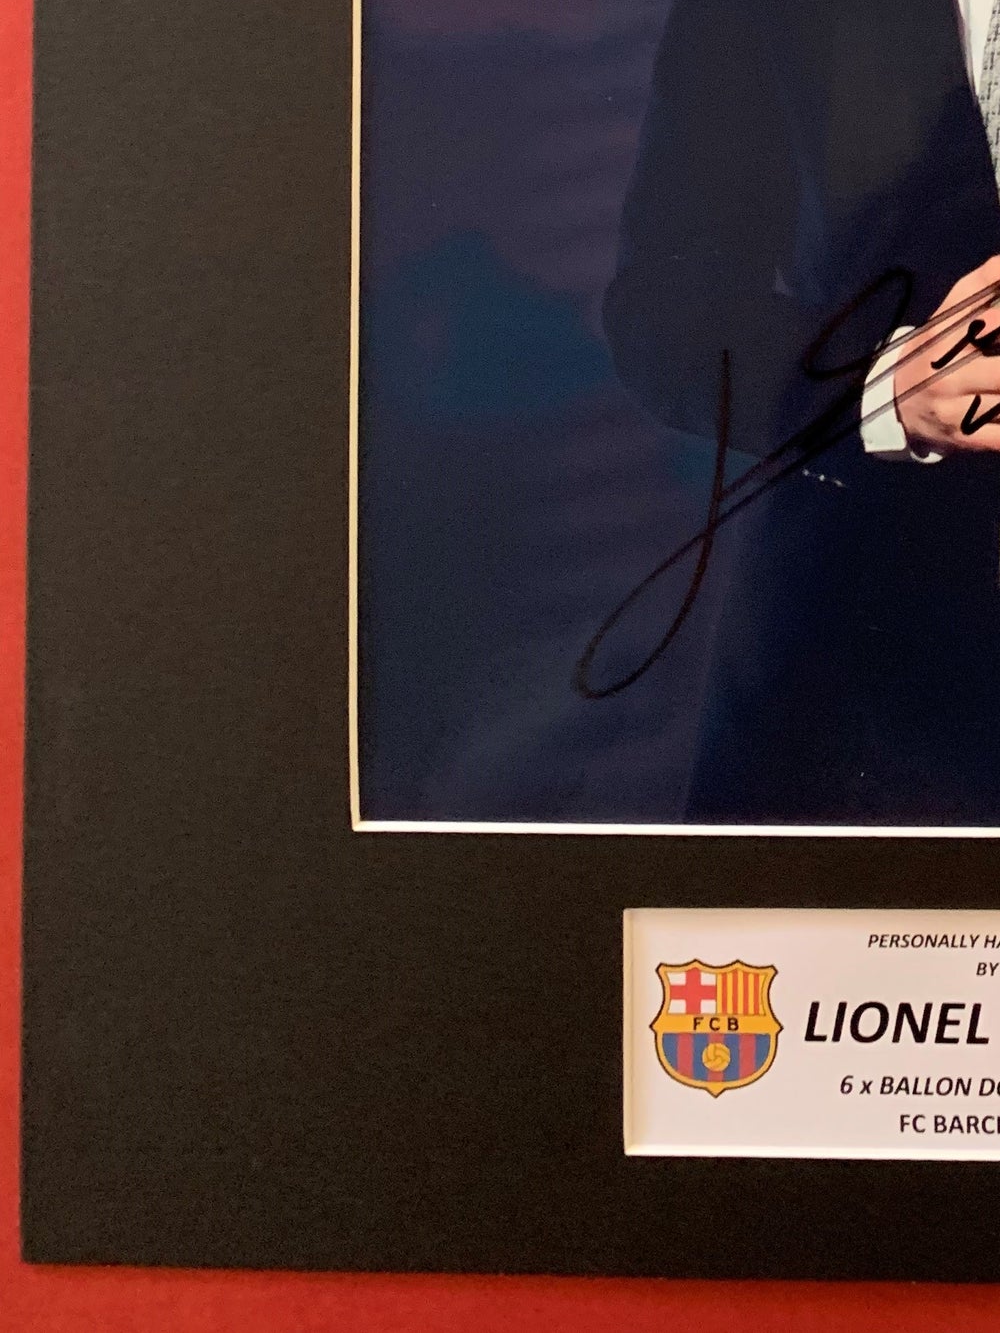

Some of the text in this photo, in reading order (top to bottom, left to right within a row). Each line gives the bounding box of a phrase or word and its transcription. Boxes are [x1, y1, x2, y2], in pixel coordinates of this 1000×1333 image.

[867, 933, 980, 949] PERSONALLY
[976, 962, 1000, 977] BY
[804, 1001, 990, 1045] LIONEL
[840, 1075, 854, 1095] 6
[859, 1080, 873, 1096] x
[879, 1076, 972, 1097] BALLON
[899, 1114, 926, 1134] FC
